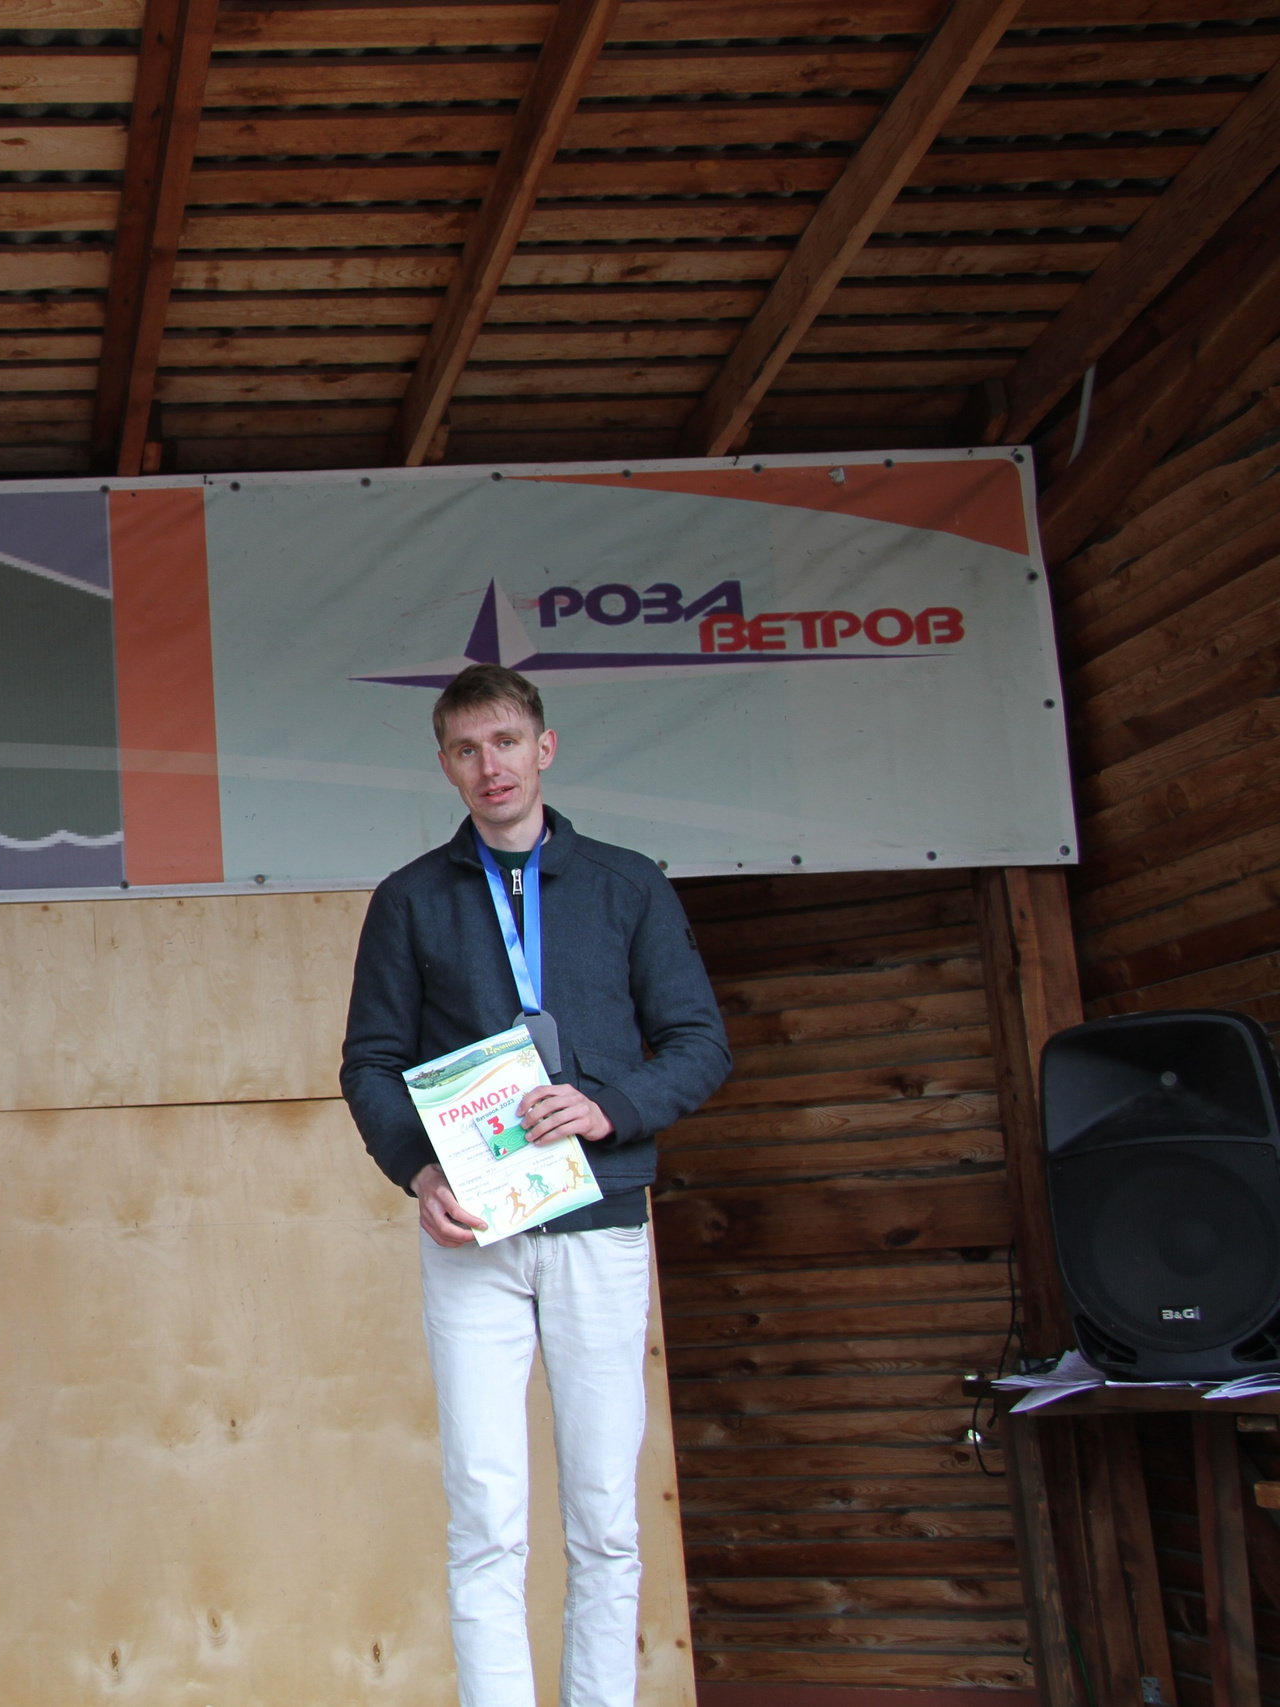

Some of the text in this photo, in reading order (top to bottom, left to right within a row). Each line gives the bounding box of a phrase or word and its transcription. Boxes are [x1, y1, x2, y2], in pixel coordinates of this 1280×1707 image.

[538, 580, 744, 628] РОЗА
[699, 607, 965, 653] ВЕТРОВ
[438, 1083, 520, 1127] ГРАМОТА
[486, 1115, 505, 1135] 3
[1161, 1308, 1195, 1320] B&G
